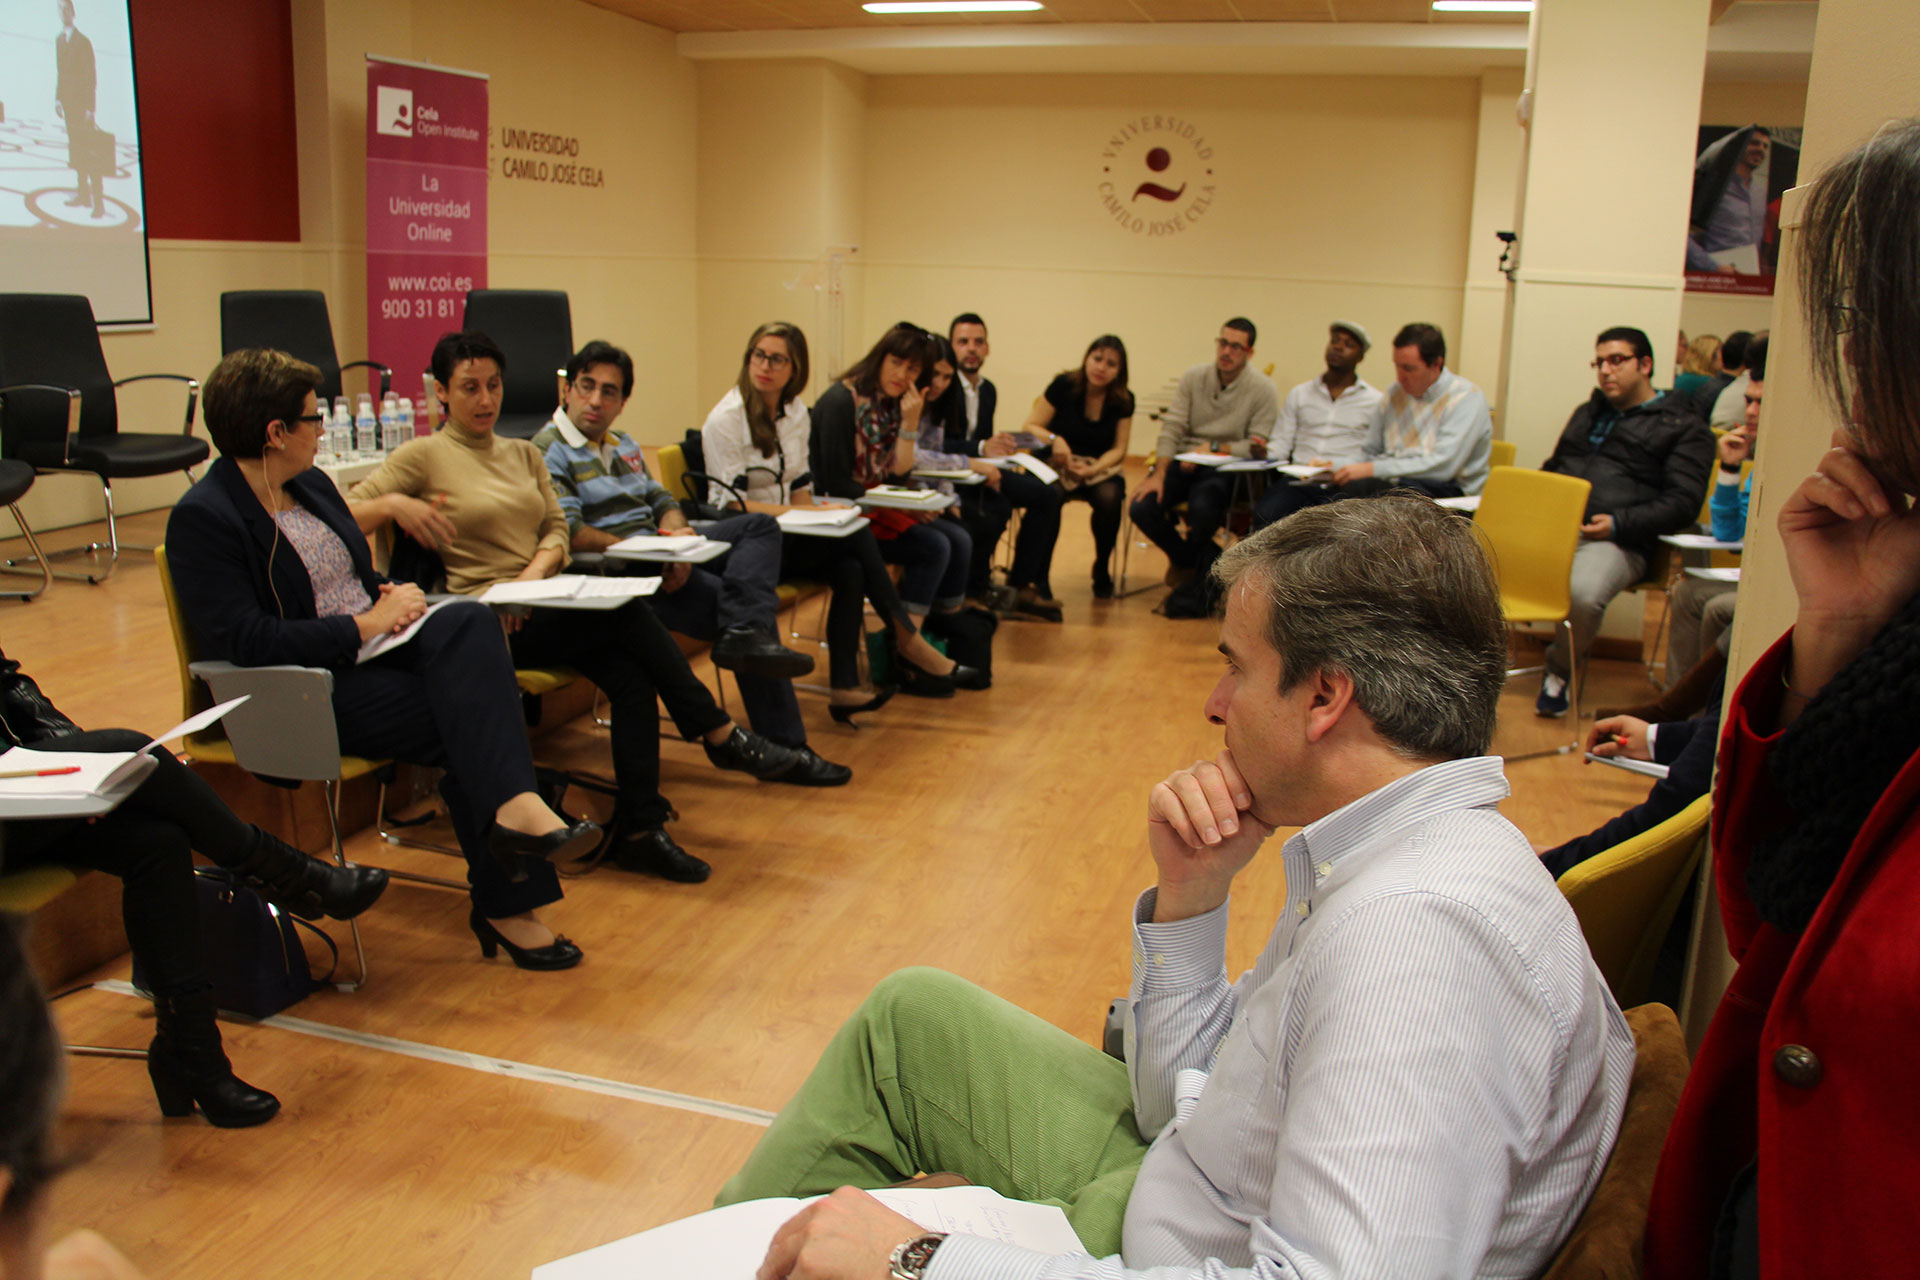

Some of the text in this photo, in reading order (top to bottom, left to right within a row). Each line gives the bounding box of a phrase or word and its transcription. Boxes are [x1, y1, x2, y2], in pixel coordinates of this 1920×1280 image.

[416, 105, 439, 121] Cela
[416, 120, 480, 141] Open Institute
[502, 127, 580, 157] UNIVERSIDAD
[421, 174, 439, 192] La
[502, 157, 605, 188] CAMILO JOSÉ CELA
[389, 197, 471, 218] Universidad
[1098, 182, 1144, 233] CAMILO
[1184, 184, 1216, 222] CELA
[407, 222, 452, 242] Online
[388, 272, 473, 292] www.coi.es
[382, 298, 411, 319] 900
[415, 298, 432, 318] 31
[438, 298, 455, 318] 81
